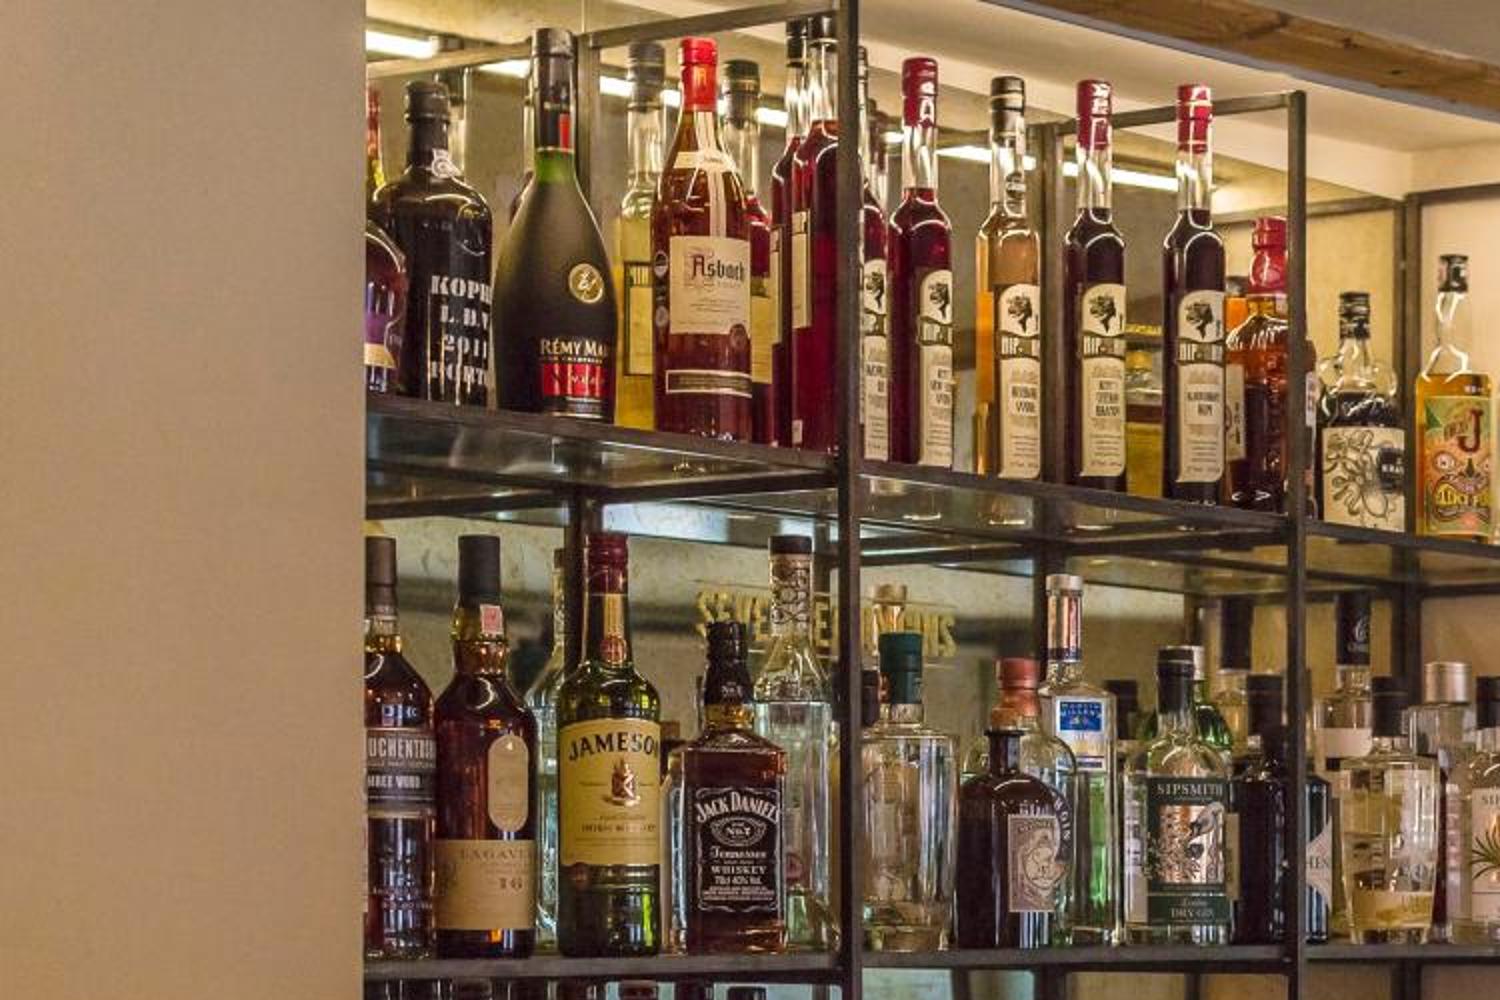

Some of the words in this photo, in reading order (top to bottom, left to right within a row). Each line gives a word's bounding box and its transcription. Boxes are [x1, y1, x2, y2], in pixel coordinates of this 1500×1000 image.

[431, 361, 489, 386] PORT
[1157, 783, 1223, 795] SIPSMITH
[696, 796, 731, 823] JACK
[711, 866, 767, 875] WHISKEY
